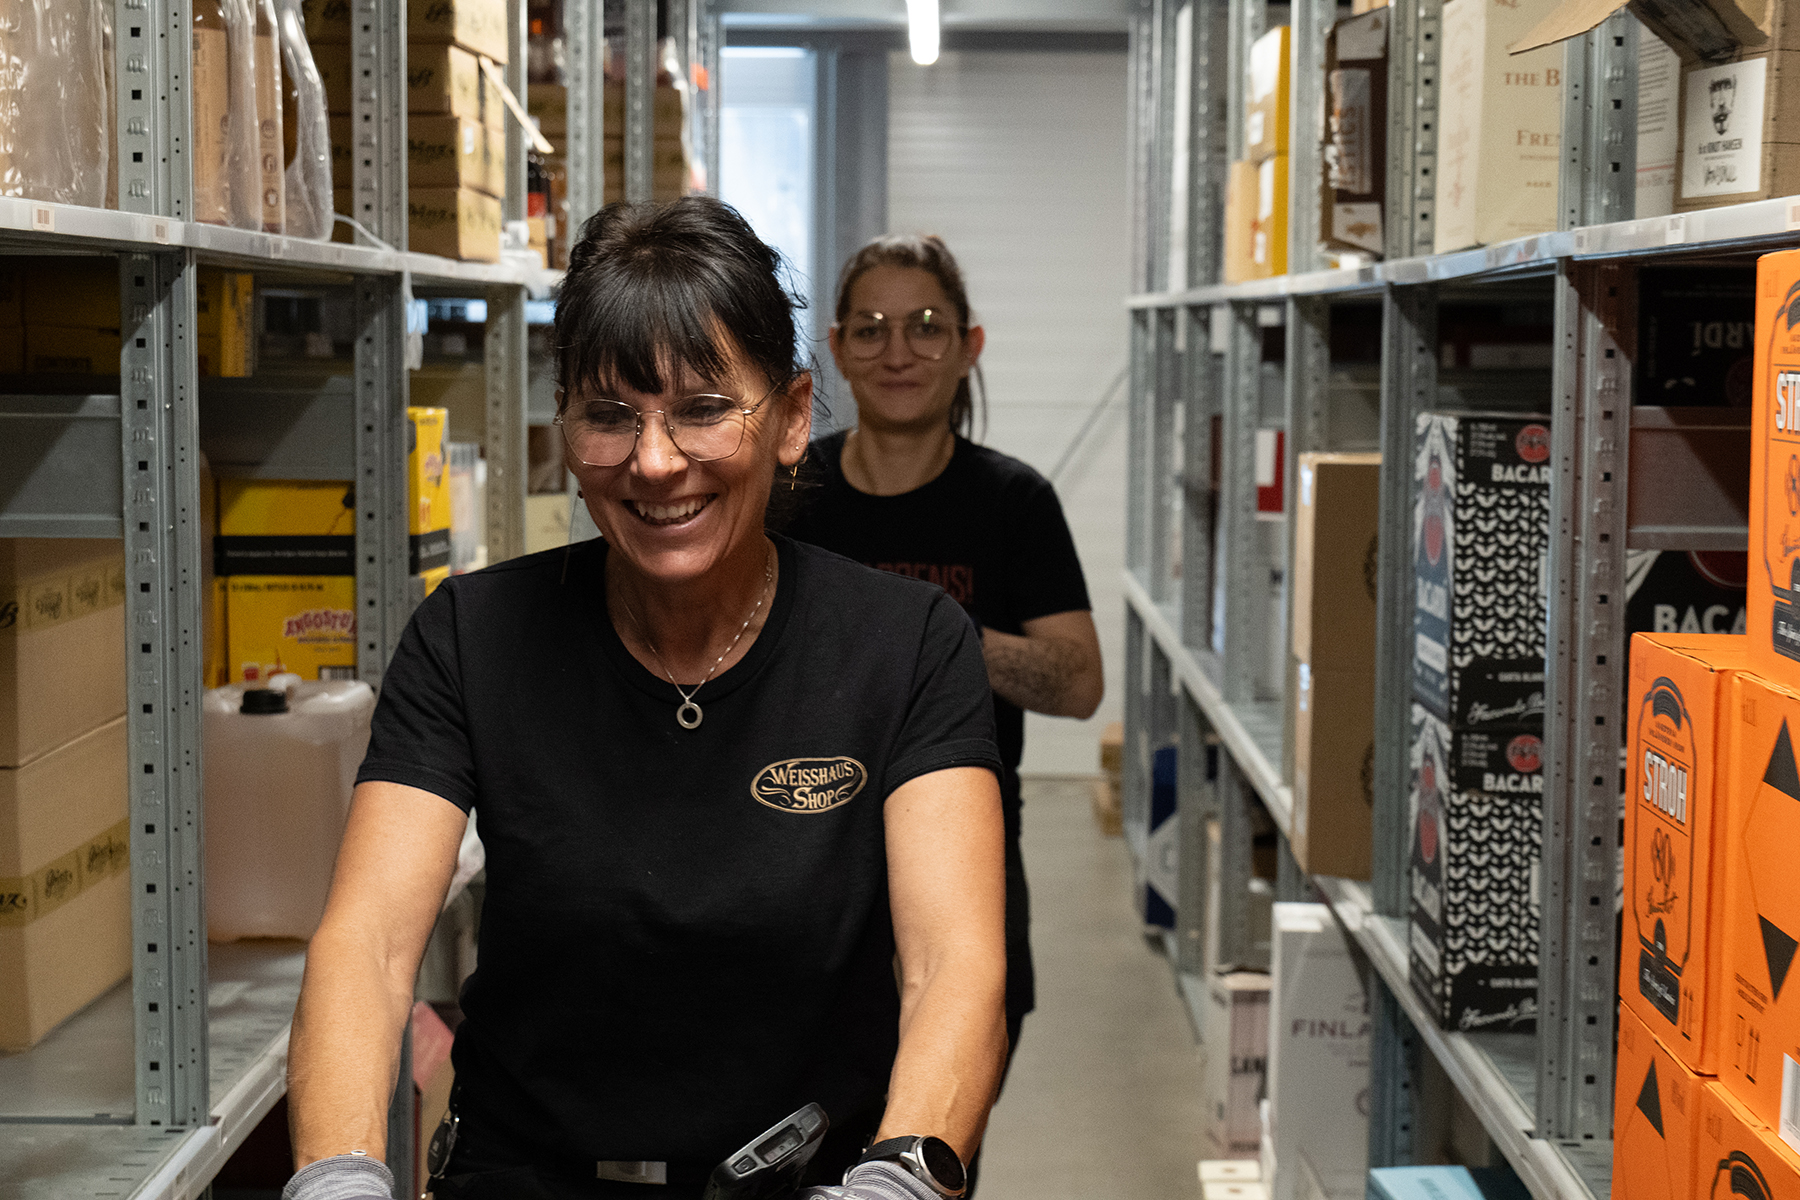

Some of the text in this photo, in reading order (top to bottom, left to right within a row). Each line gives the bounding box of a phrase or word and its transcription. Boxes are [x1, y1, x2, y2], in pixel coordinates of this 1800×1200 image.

[1504, 72, 1540, 86] THE
[769, 761, 855, 786] WEISSHAUS
[791, 786, 835, 809] SHOP
[1643, 749, 1687, 826] STROH
